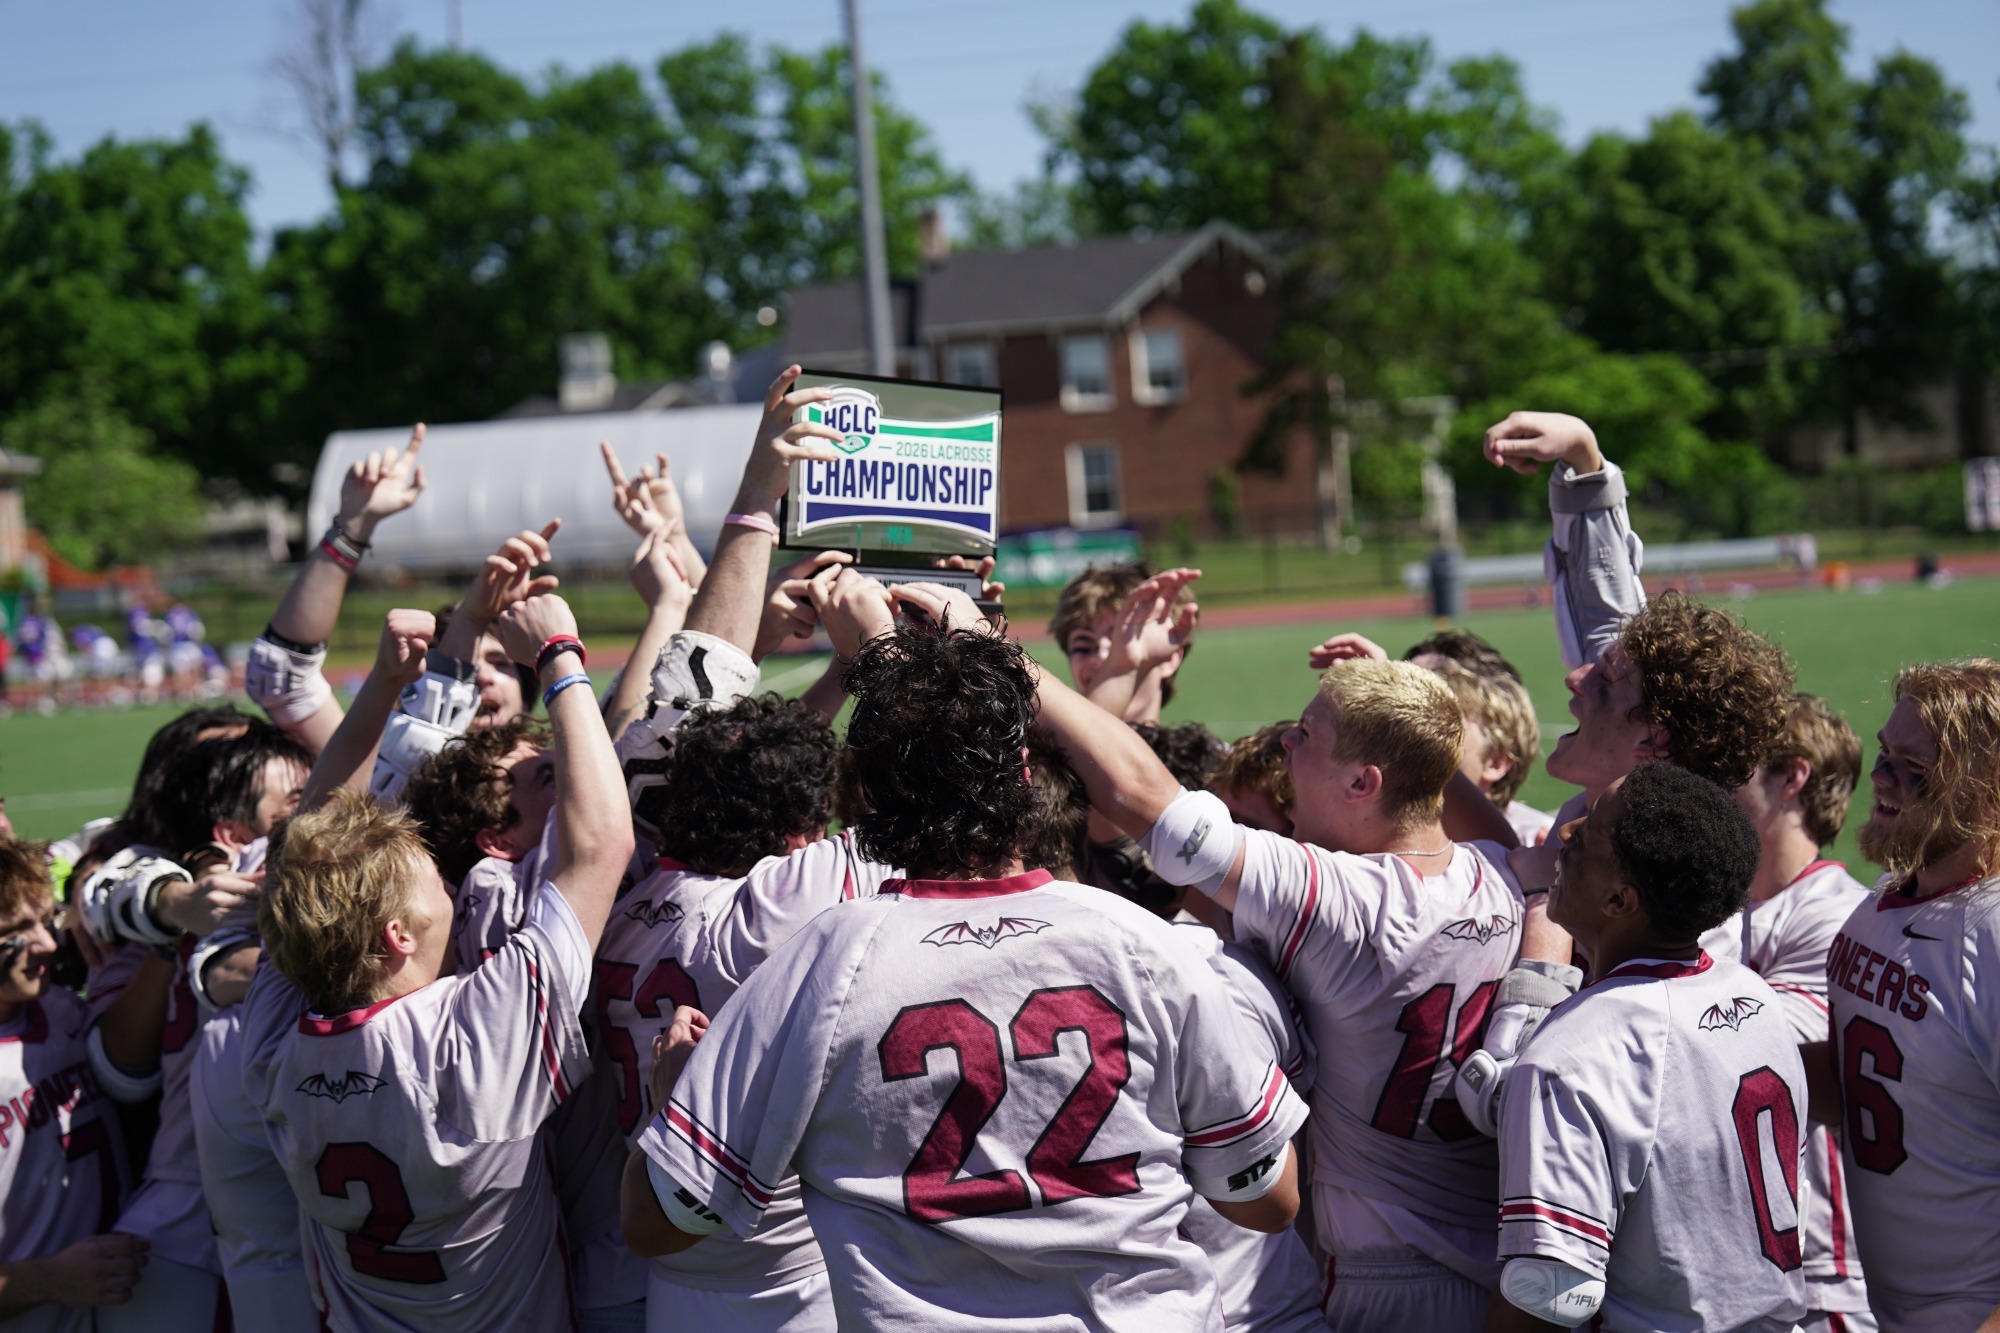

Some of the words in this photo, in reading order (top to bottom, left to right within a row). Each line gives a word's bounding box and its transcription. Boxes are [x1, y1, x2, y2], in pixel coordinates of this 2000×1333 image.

[825, 404, 876, 435] HCLC
[896, 441, 928, 458] 2026
[931, 443, 992, 463] LACROSSE
[807, 458, 992, 506] CHAMPIONSHIP
[877, 984, 1144, 1225] 22
[1829, 1000, 1909, 1177] 6
[314, 1142, 448, 1284] 2
[1226, 1153, 1278, 1193] STX
[1731, 1065, 1803, 1274] 0
